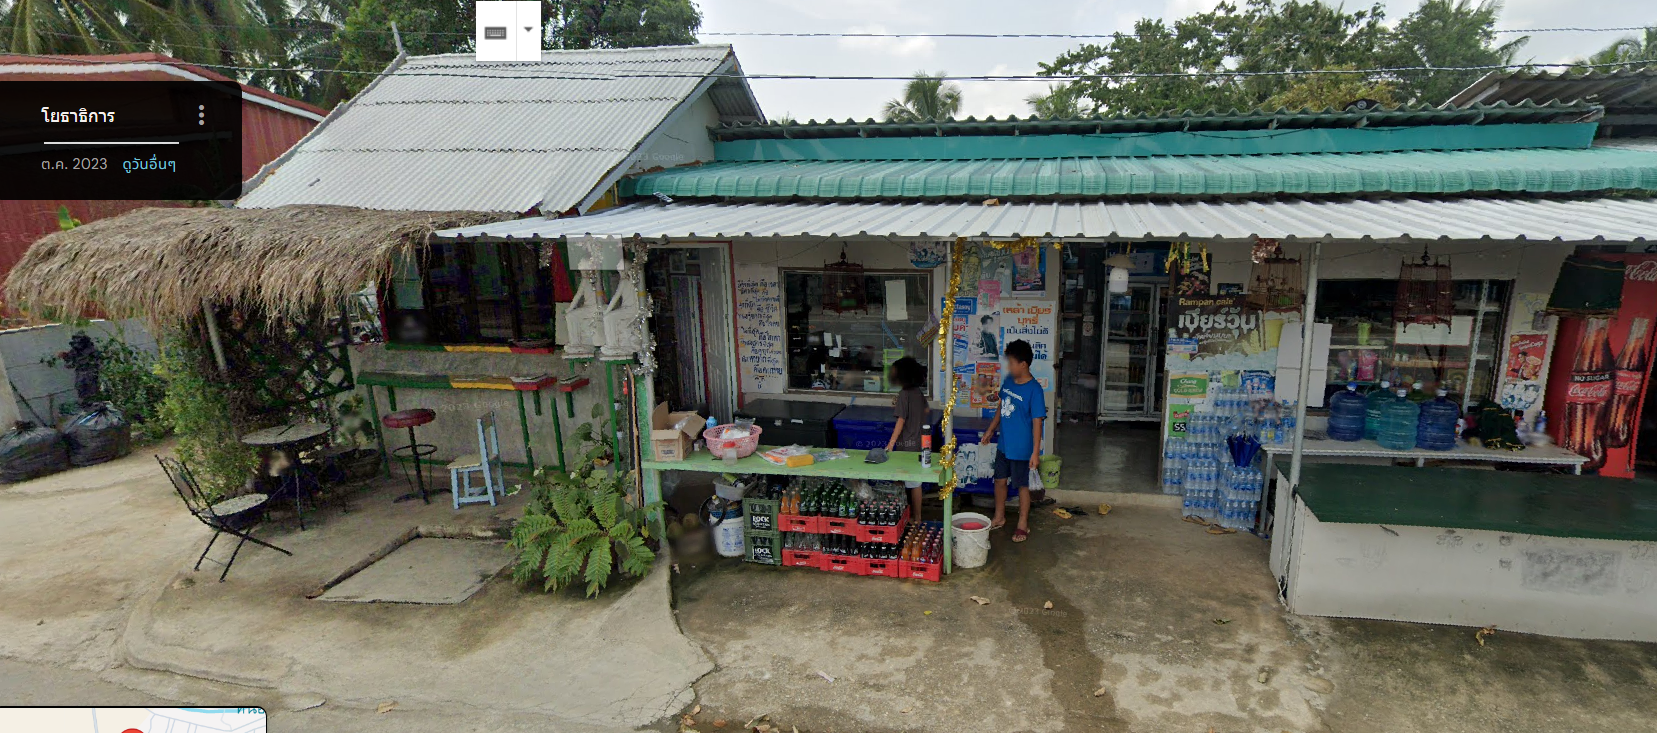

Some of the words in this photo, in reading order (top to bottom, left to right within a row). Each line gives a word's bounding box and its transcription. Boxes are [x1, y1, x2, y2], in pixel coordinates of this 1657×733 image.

[1178, 298, 1214, 307] Rampan
[1003, 303, 1026, 314] เหล้า
[1027, 304, 1053, 315] เบียร์
[1017, 313, 1040, 326] บุหรี่
[1178, 307, 1256, 340] เบียร์วุ้น
[1006, 324, 1049, 335] เป็นสิ่งไม่ดี
[1568, 382, 1609, 397] Coca-Cola
[752, 515, 770, 523] ROCK
